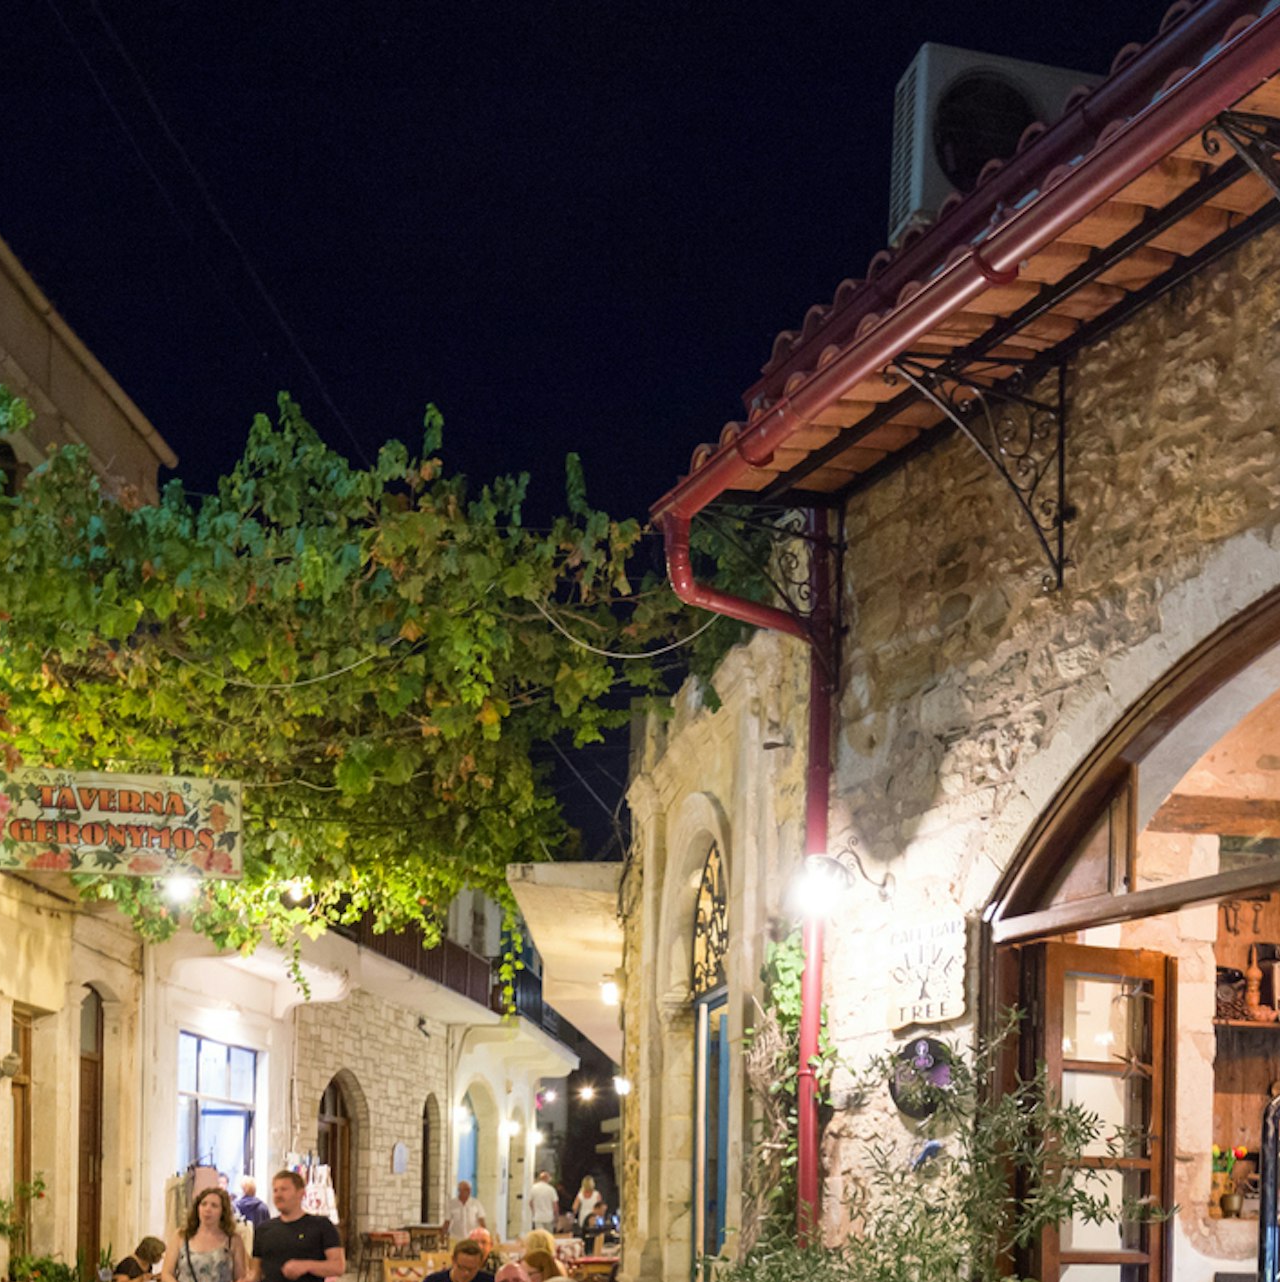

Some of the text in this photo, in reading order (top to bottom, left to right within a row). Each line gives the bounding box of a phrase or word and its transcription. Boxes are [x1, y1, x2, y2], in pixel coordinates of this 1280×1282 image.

[37, 784, 187, 816] TAVERNA
[8, 817, 216, 852] GERONYMOS
[891, 944, 959, 985] OLIVE
[898, 1001, 949, 1023] TREE
